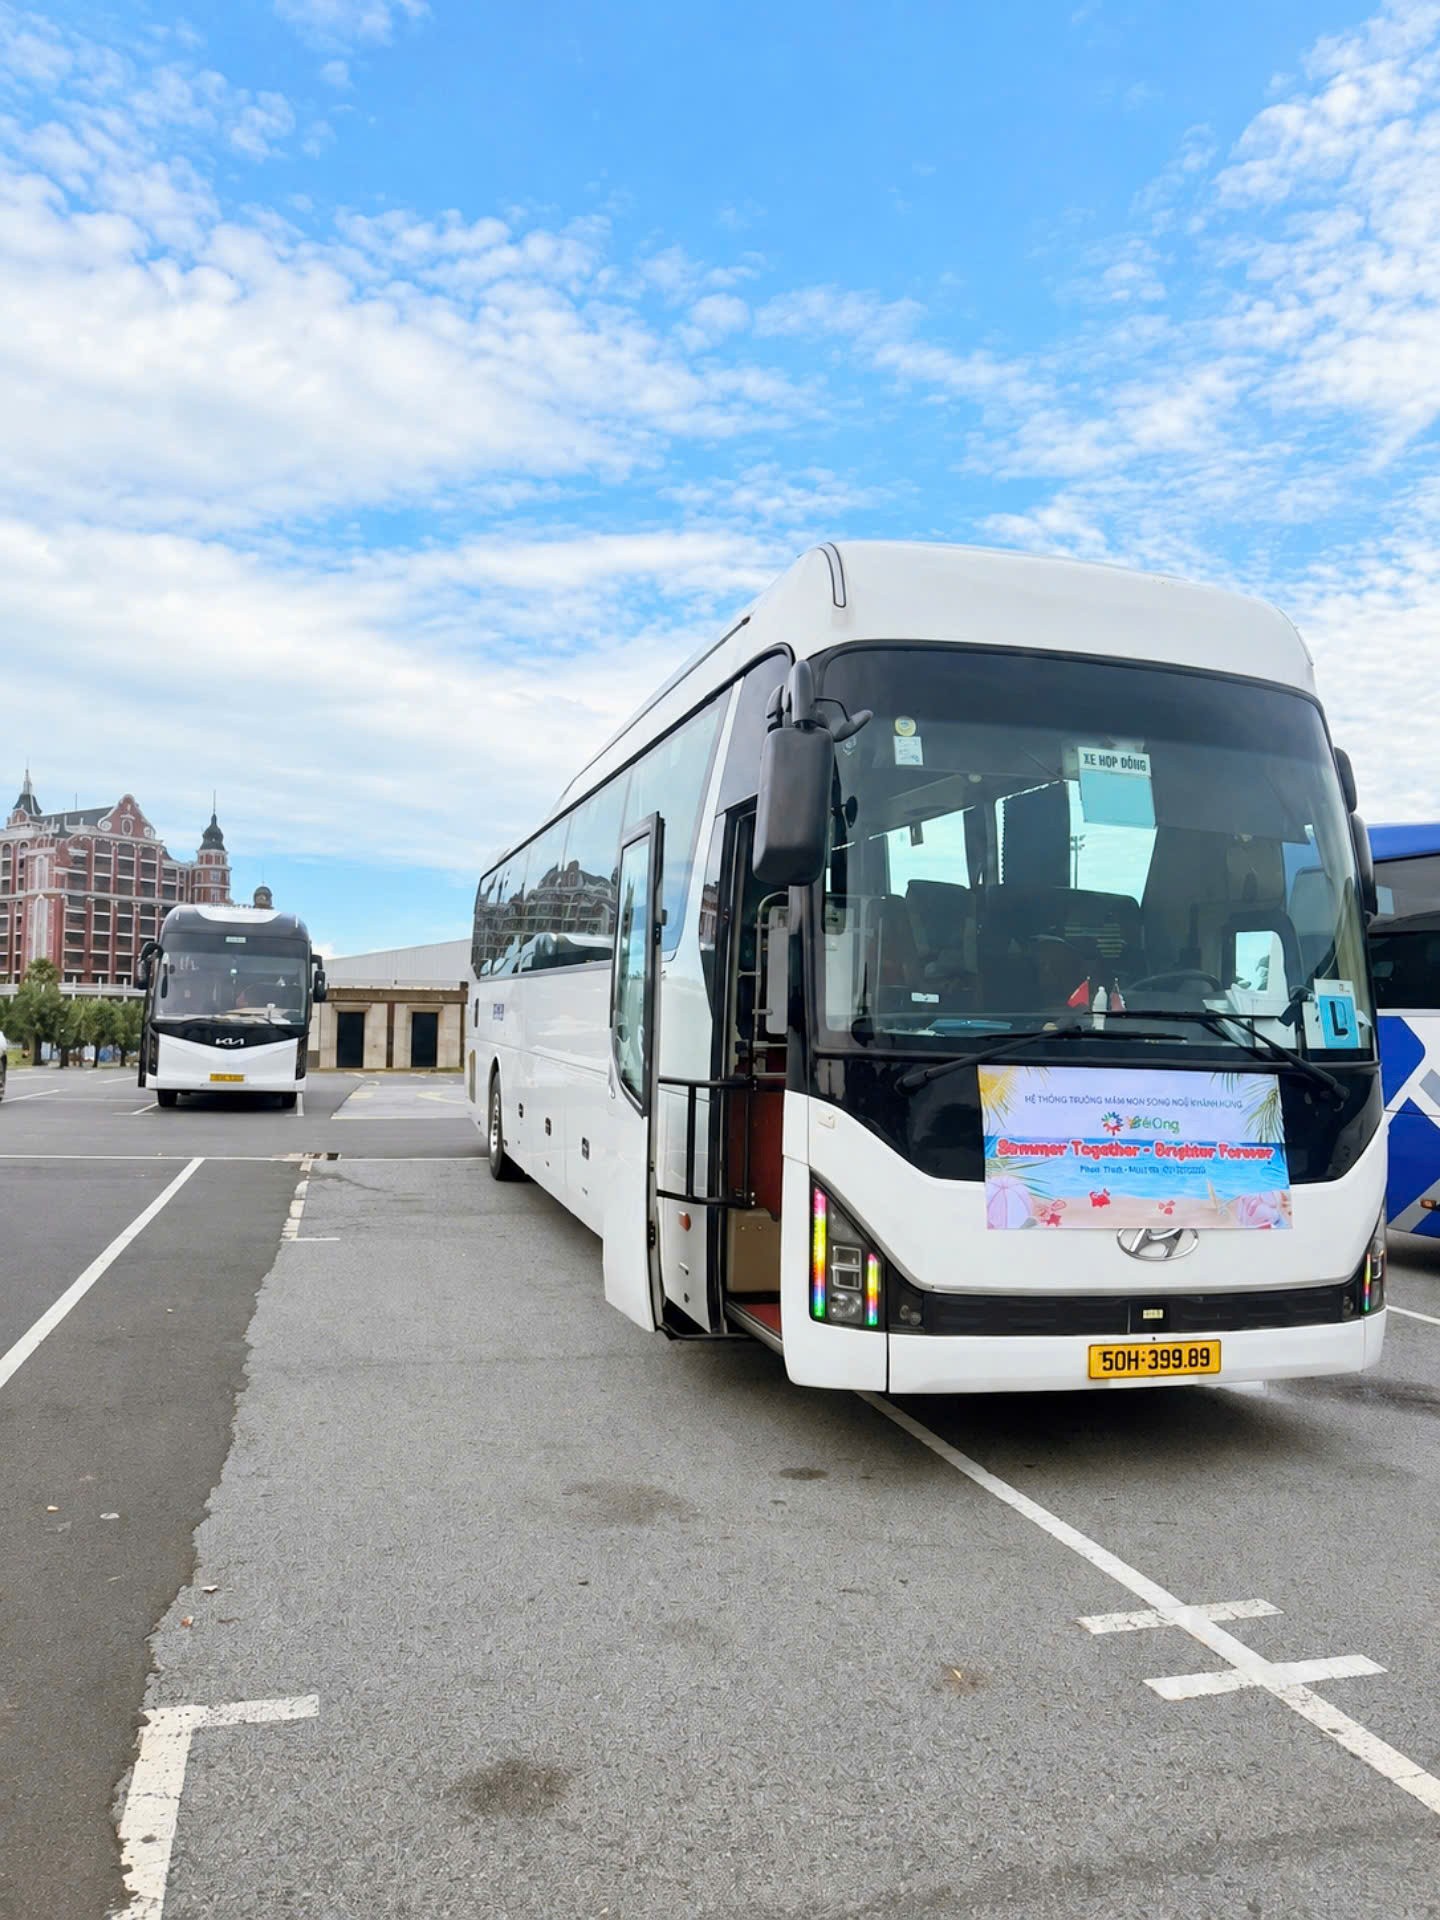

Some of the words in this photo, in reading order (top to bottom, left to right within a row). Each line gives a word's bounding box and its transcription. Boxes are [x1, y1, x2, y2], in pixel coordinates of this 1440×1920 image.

[1083, 753, 1096, 765] XE
[215, 1037, 245, 1045] KIA
[997, 1138, 1067, 1157] Summer
[1071, 1140, 1140, 1160] Together
